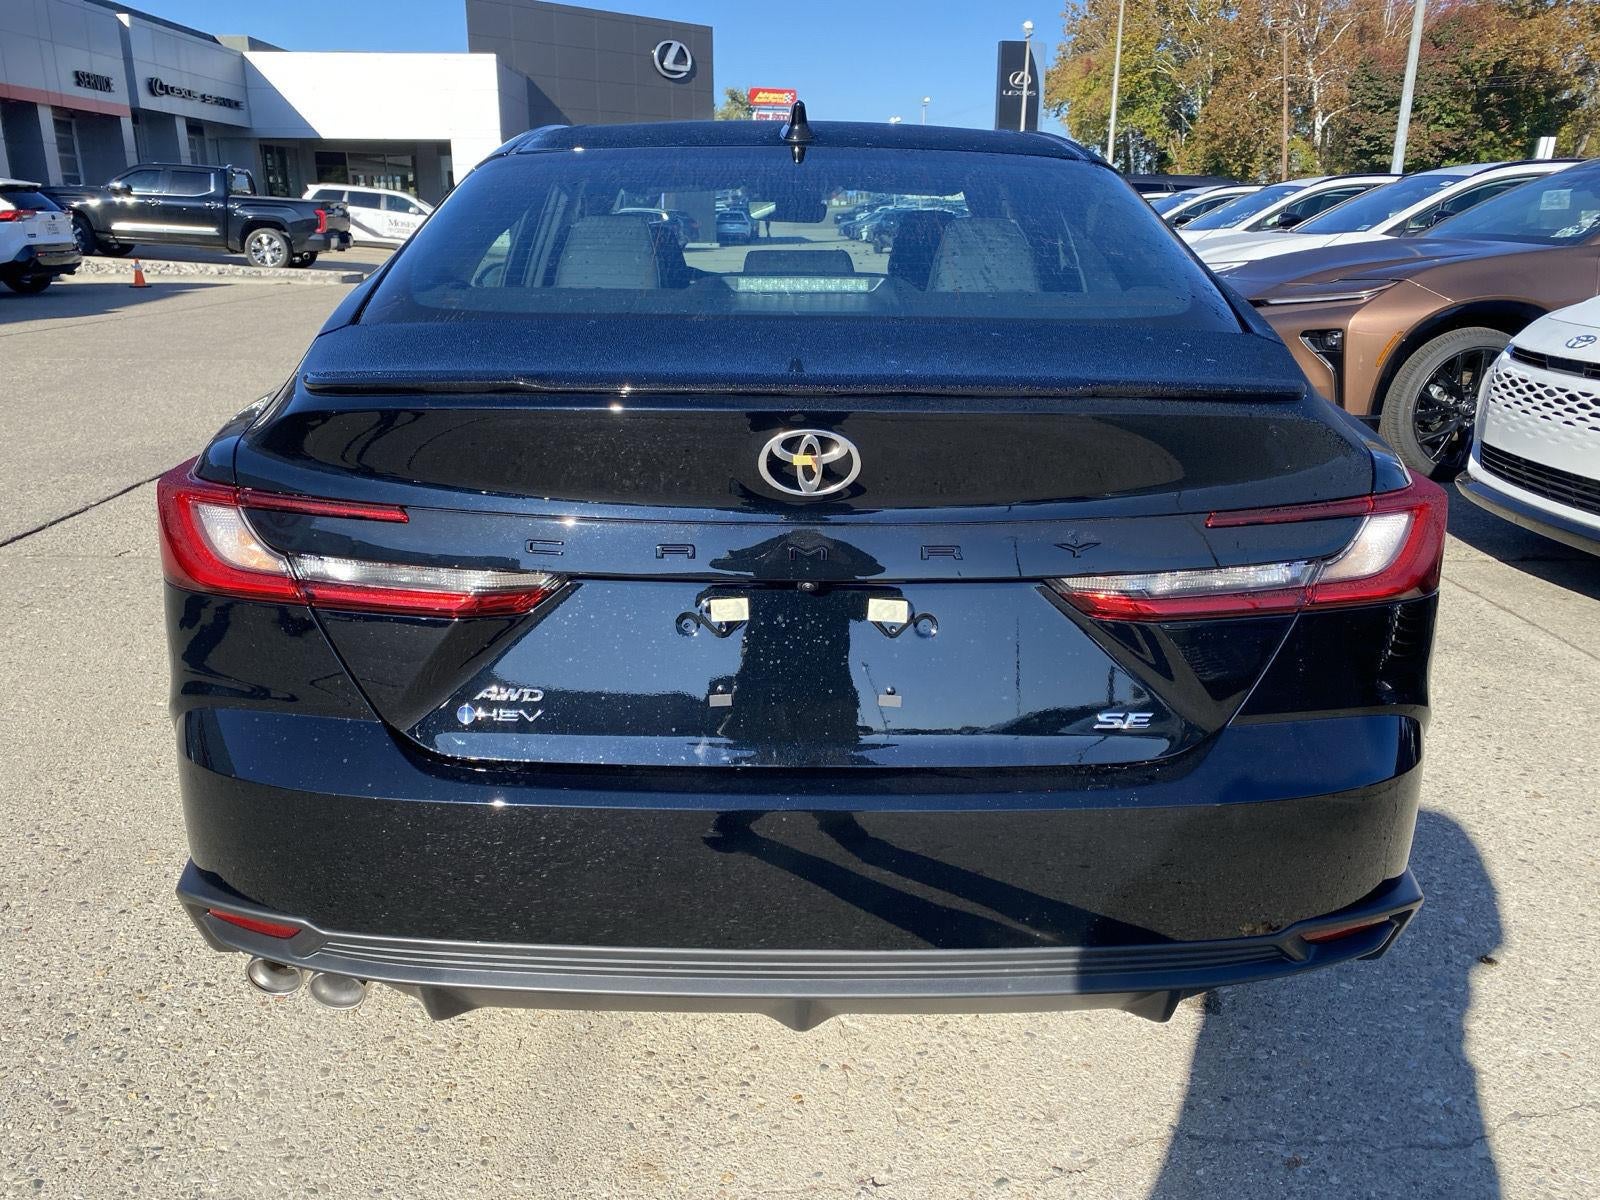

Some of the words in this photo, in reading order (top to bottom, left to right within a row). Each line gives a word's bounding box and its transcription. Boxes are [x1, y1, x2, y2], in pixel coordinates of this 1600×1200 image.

[75, 71, 115, 92] SERVICE
[203, 94, 244, 111] SERVICE
[525, 539, 1101, 560] CAMRY
[473, 685, 544, 702] AWD
[476, 707, 544, 722] HEV
[1093, 712, 1154, 729] SE
